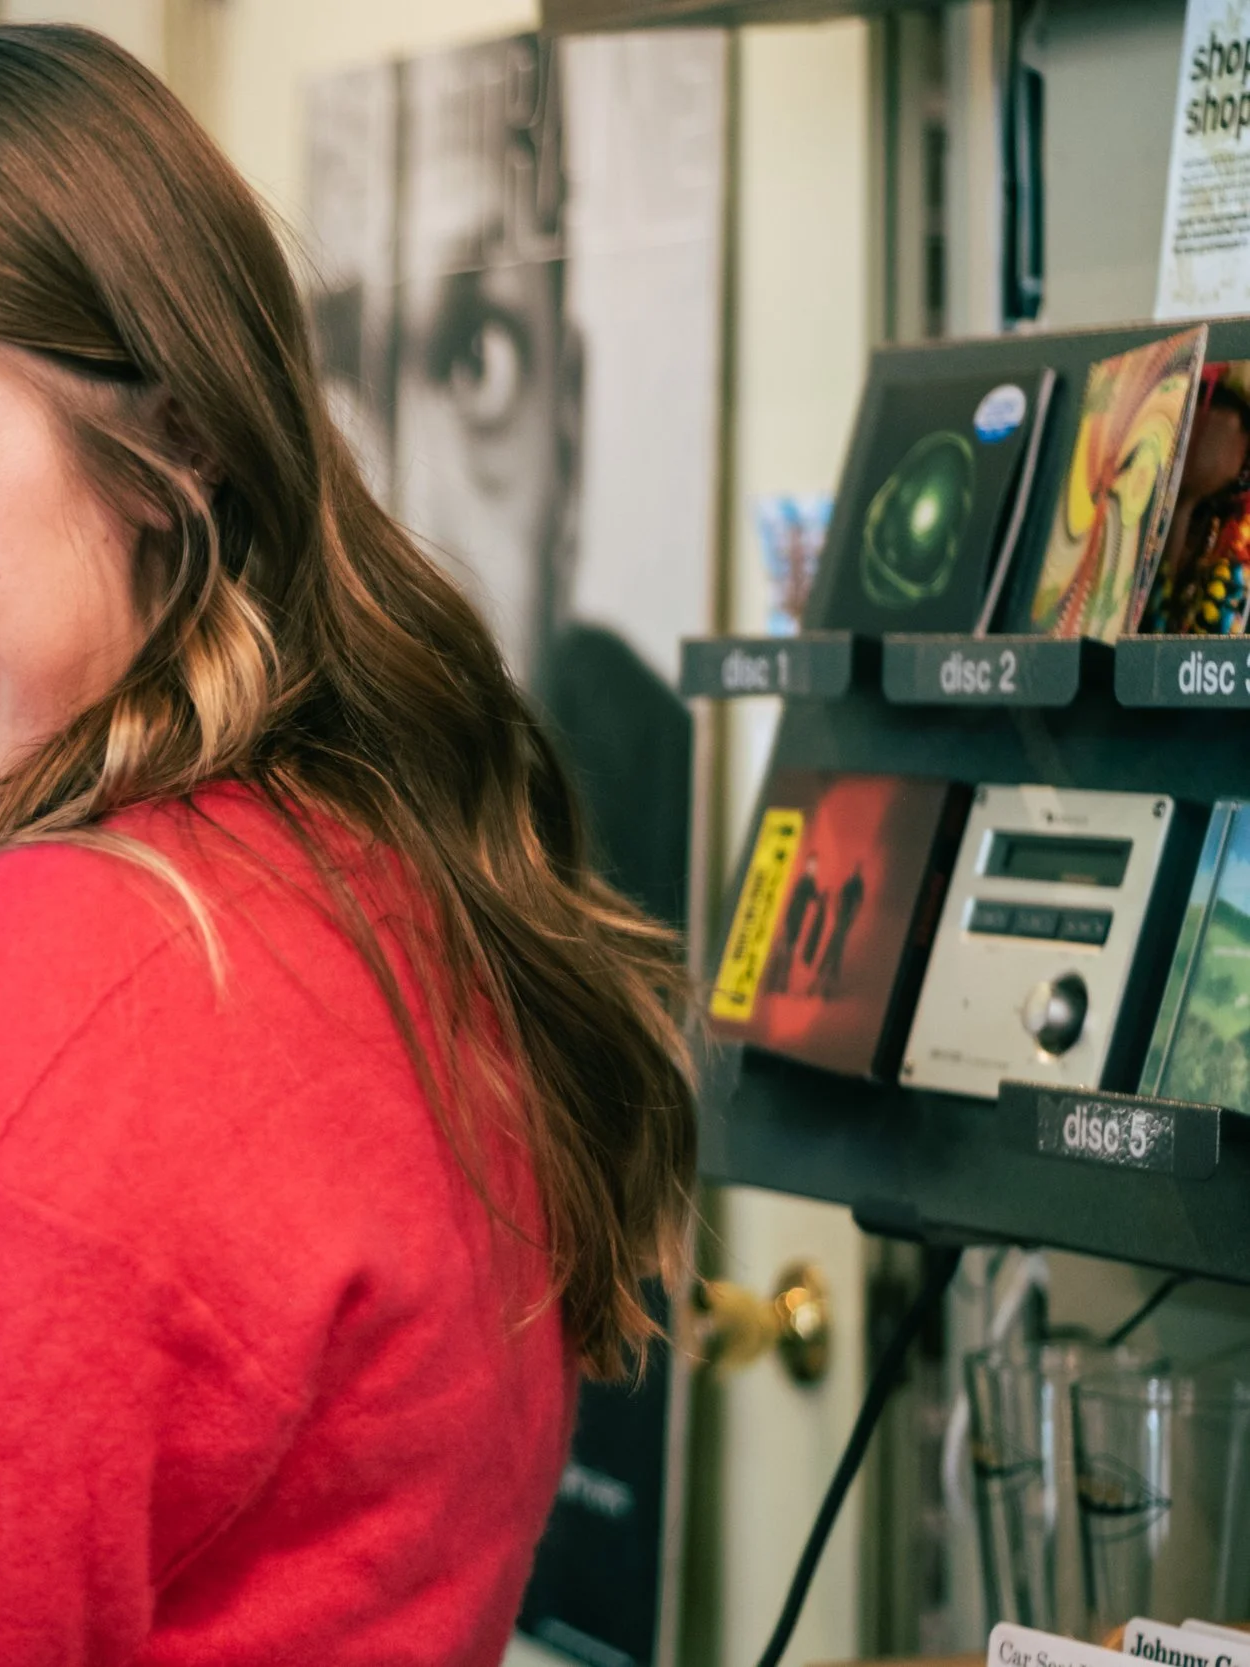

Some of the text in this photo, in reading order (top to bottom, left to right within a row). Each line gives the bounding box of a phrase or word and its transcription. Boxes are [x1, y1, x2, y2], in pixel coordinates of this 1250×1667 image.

[720, 648, 790, 691] disc 1
[940, 649, 1017, 695] disc 2
[1178, 650, 1236, 696] disc
[1062, 1104, 1147, 1159] disc 5
